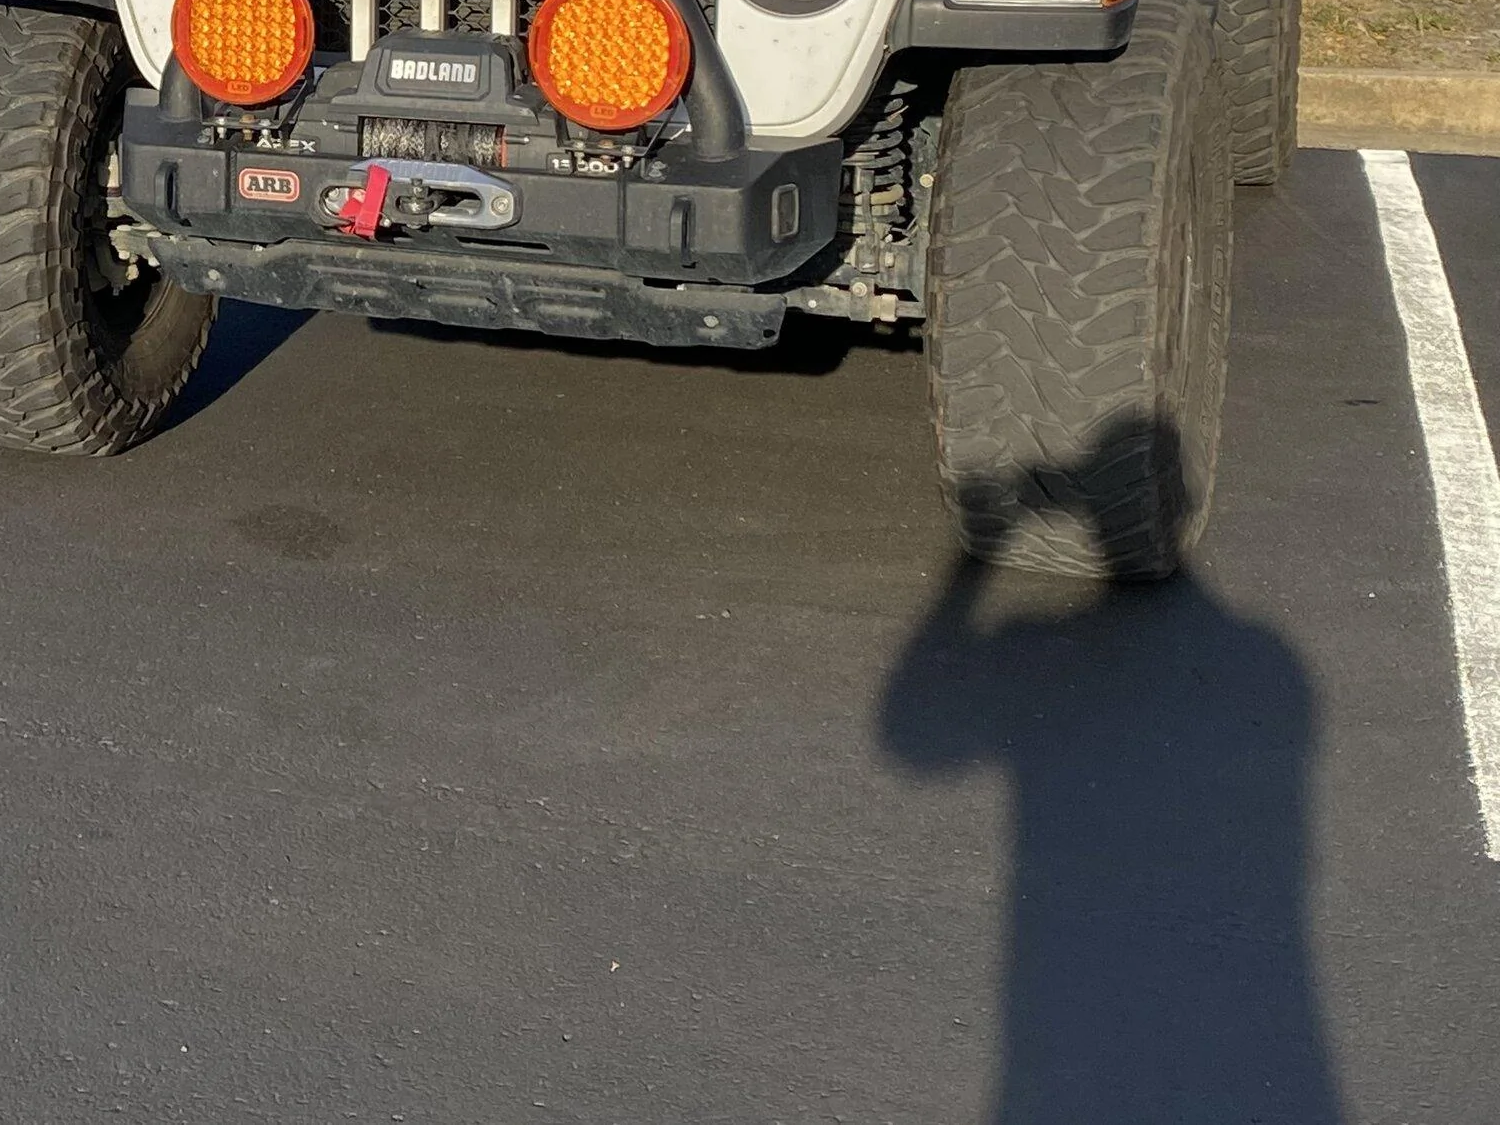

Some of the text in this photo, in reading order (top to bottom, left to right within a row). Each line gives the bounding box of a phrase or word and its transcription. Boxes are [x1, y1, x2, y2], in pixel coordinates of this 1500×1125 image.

[391, 59, 477, 83] BADLAND
[231, 84, 249, 92] LED
[594, 106, 614, 116] LED
[247, 176, 292, 194] ARB
